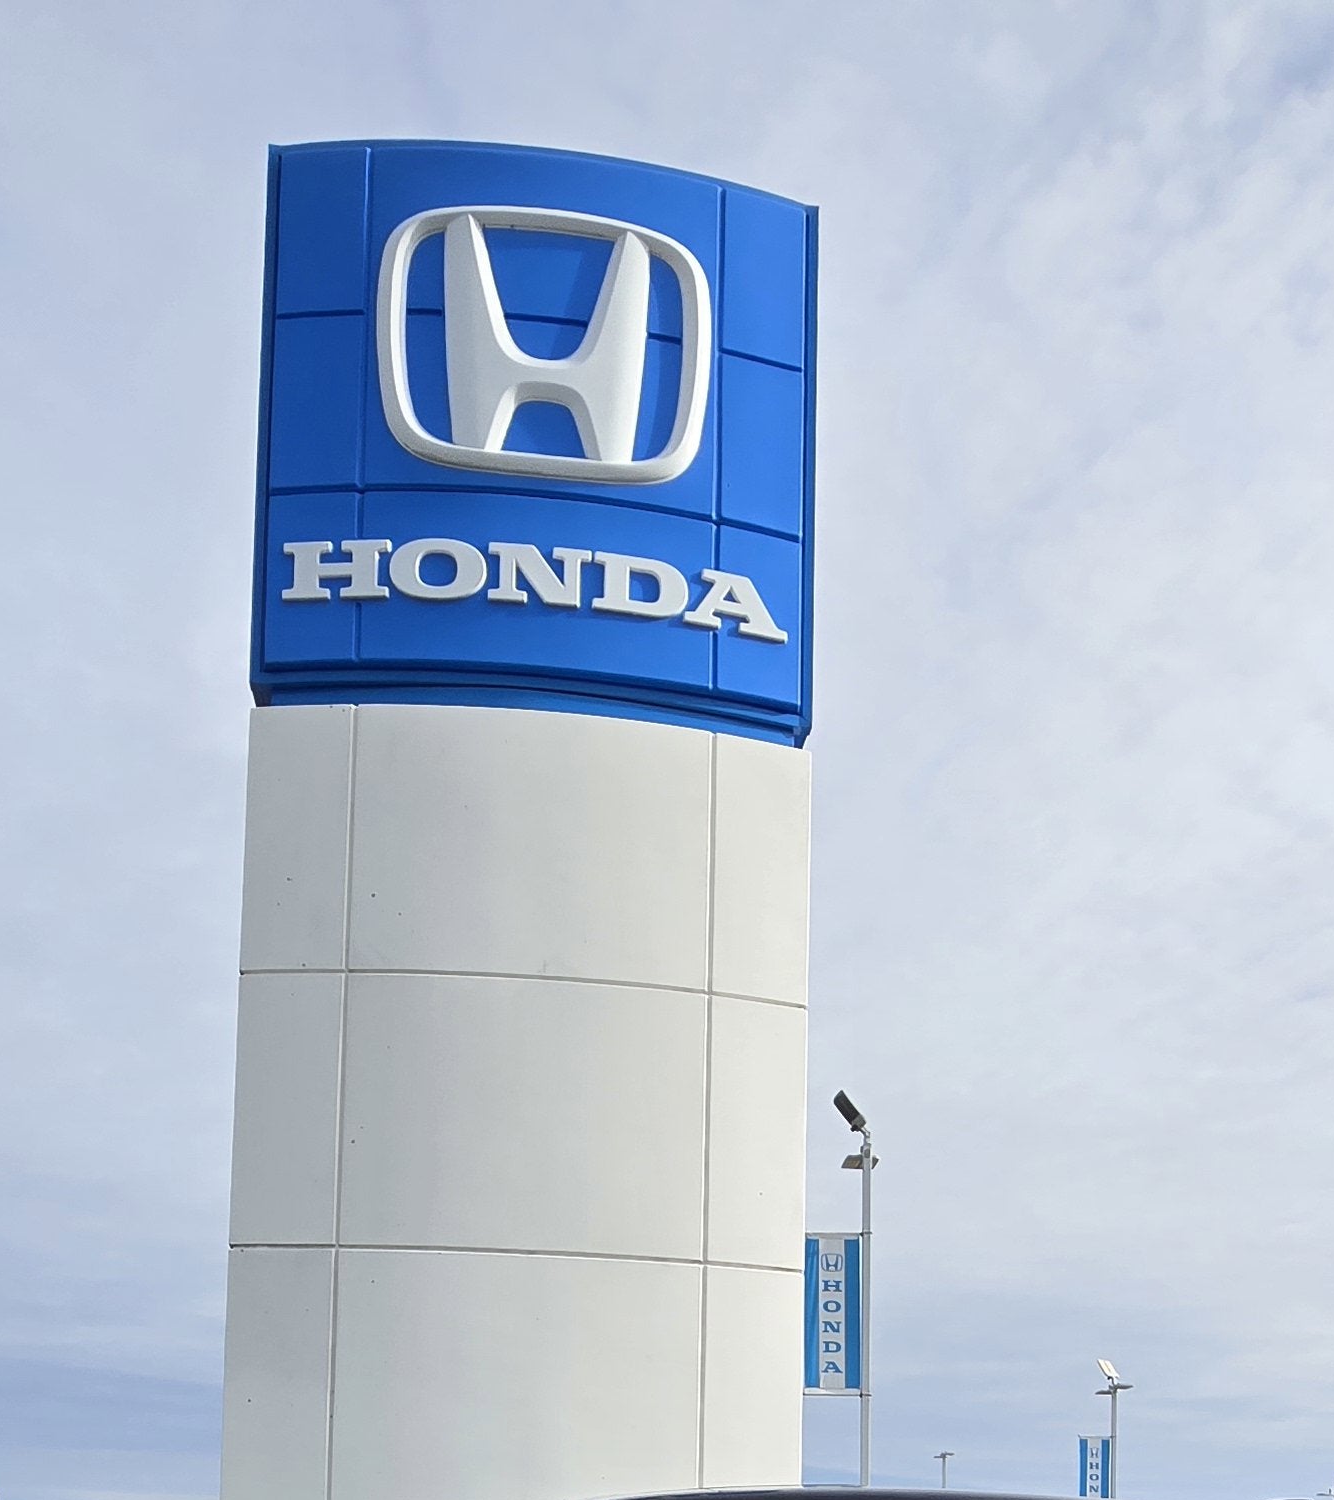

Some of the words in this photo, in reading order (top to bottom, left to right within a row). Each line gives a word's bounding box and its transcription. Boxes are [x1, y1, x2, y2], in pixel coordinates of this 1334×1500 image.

[280, 537, 789, 645] HONDA
[821, 1279, 843, 1375] HONDA
[1089, 1461, 1100, 1493] HON
